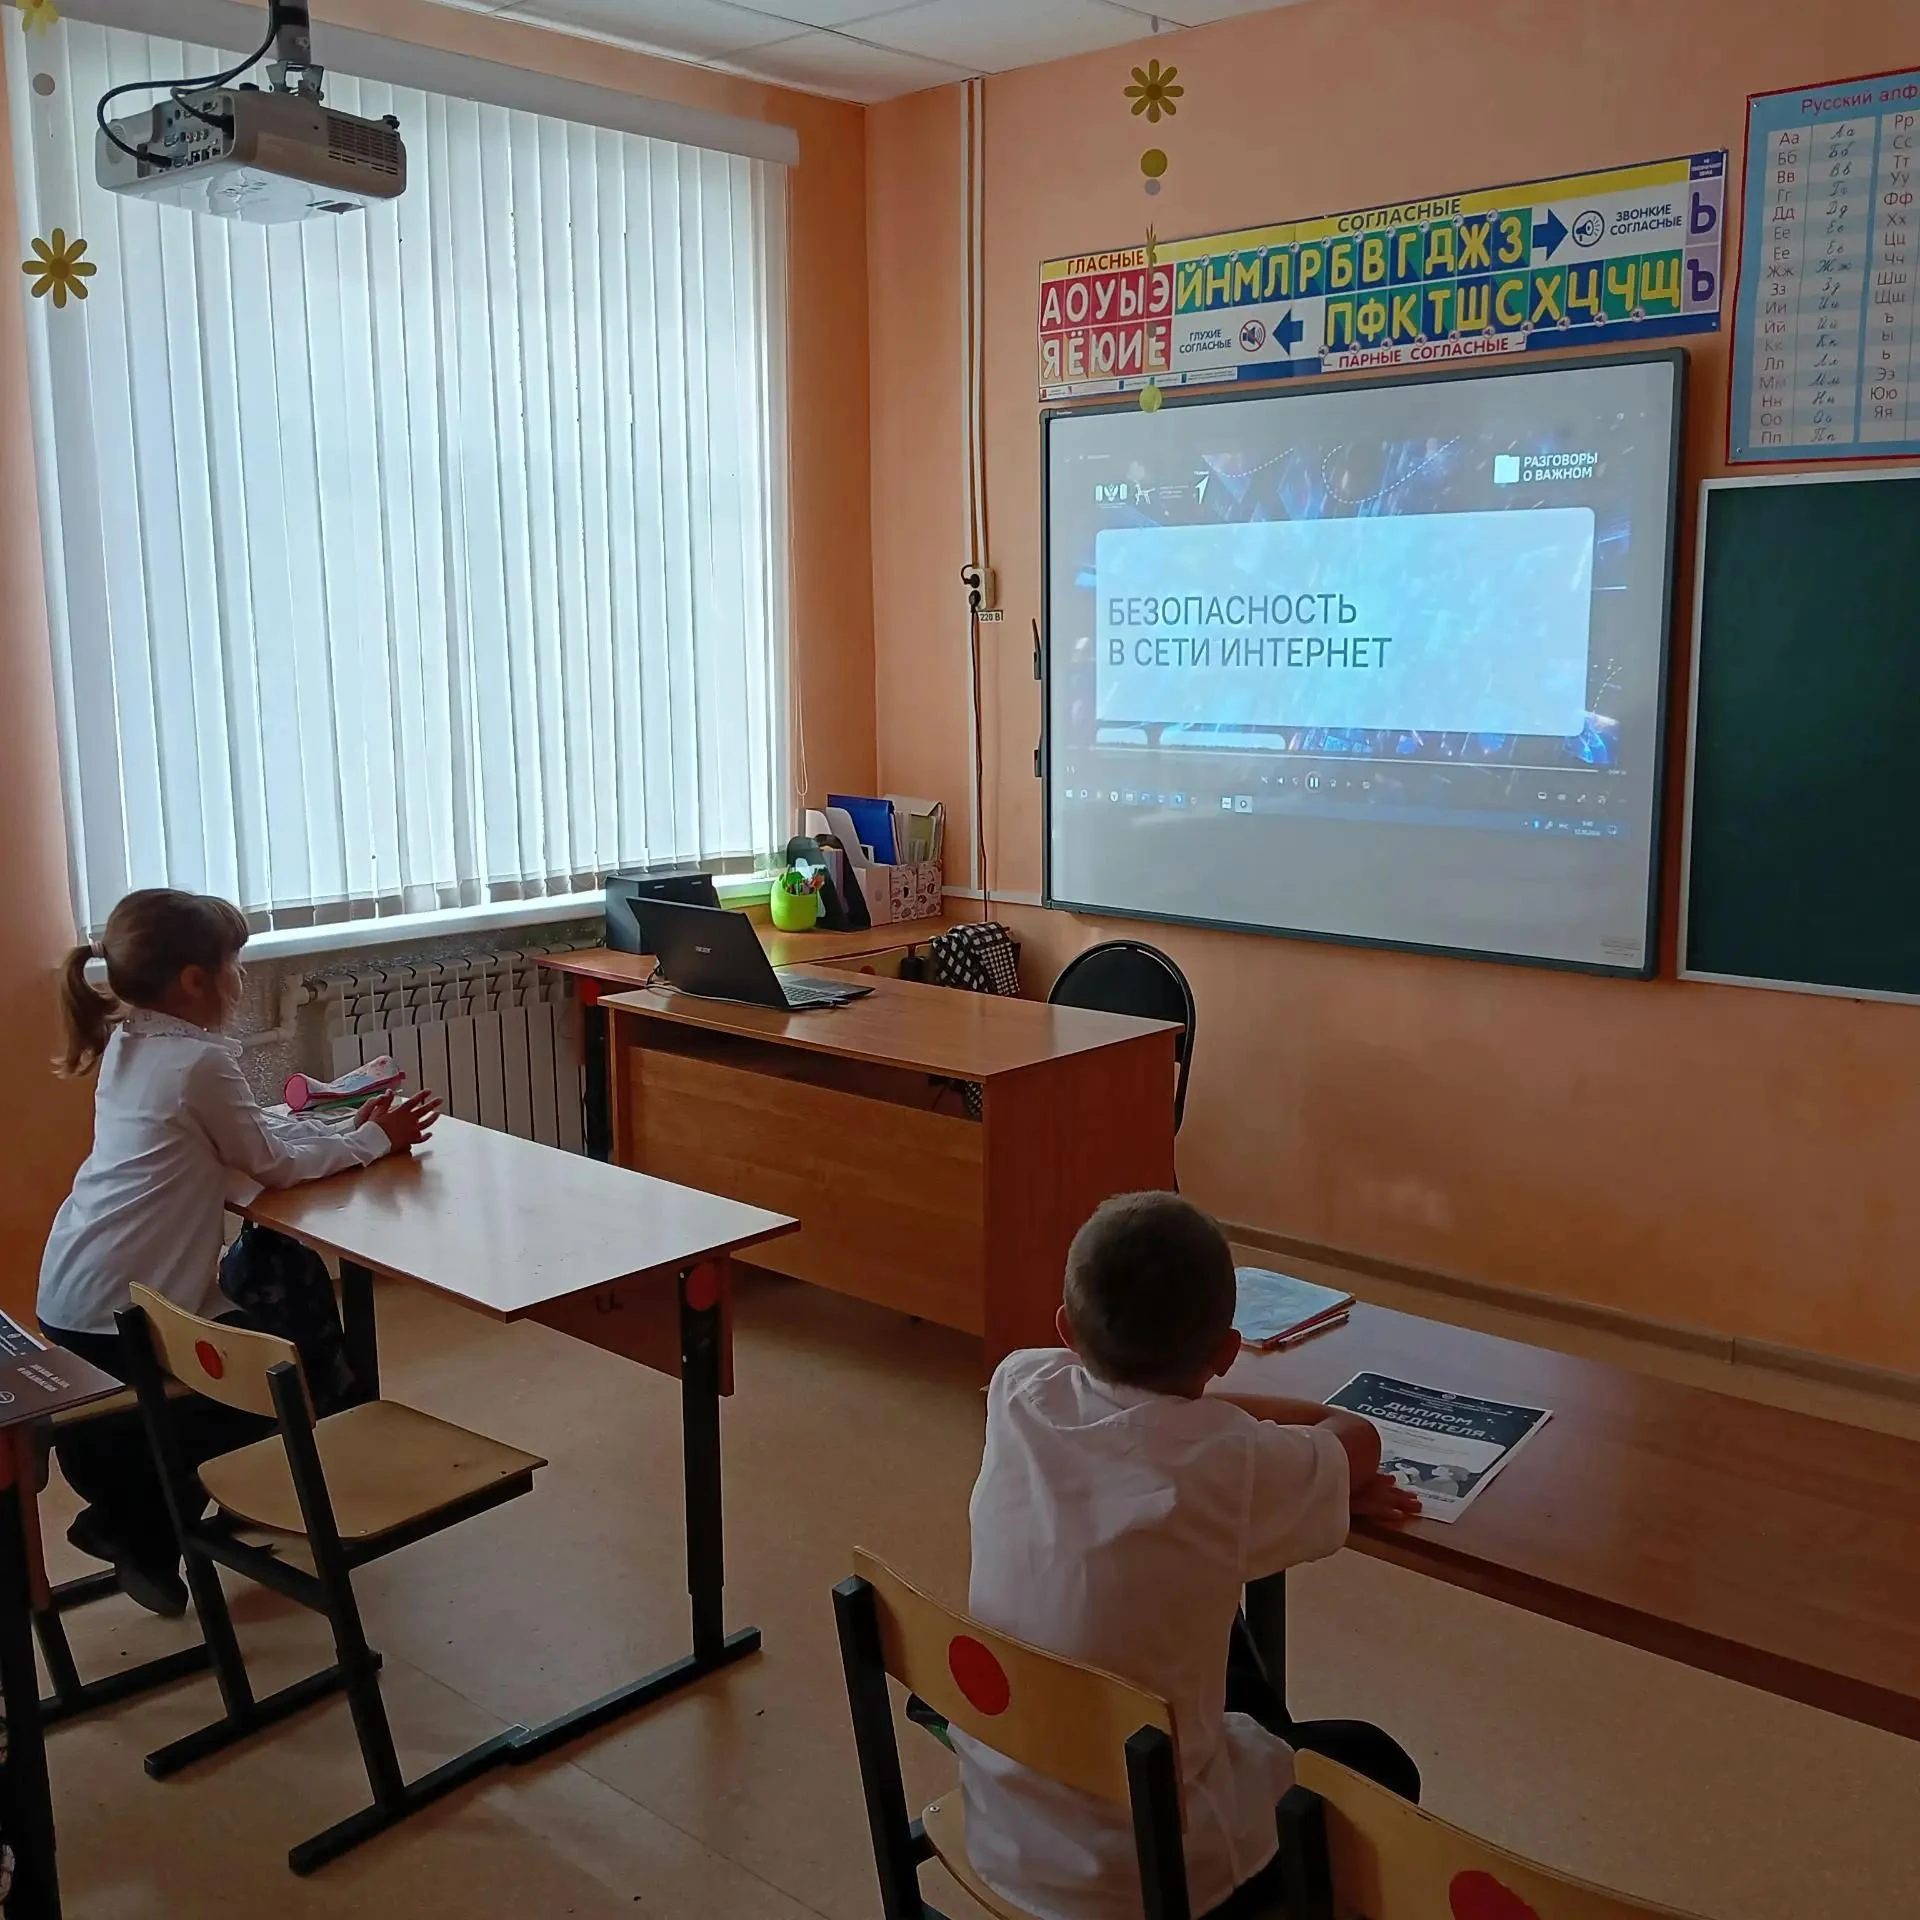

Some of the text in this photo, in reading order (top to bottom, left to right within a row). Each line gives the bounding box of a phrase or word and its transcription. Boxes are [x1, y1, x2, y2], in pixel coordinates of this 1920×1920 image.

[1801, 92, 1872, 116] Русский
[1894, 114, 1914, 130] Рр
[1779, 132, 1800, 146] Аа
[1893, 136, 1912, 150] Сс
[1777, 149, 1797, 166] Бб
[1893, 155, 1911, 169] Тт
[1777, 170, 1796, 184] Вв
[1890, 171, 1910, 187] Уу
[1883, 192, 1913, 208] Фф
[1337, 198, 1461, 234] СОГЛАСНЫЕ
[1615, 203, 1672, 223] ЗВОНКИЕ
[1772, 206, 1795, 222] Дд
[1887, 213, 1907, 227] Хх
[1609, 215, 1682, 236] СОГЛАСНЫЕ
[1066, 250, 1145, 276] ГЛАСНЫЕ
[1767, 264, 1795, 278] Жж
[1769, 282, 1786, 296] Зз
[1189, 328, 1222, 342] ГЛУХИЕ
[1179, 337, 1232, 354] СОГЛАСНЫЕ
[1338, 337, 1509, 369] ПАРНЫЕ СОГЛАСНЫЕ
[1870, 386, 1898, 401] Юю
[1760, 412, 1782, 426] Оо
[1874, 405, 1893, 419] Яя
[1761, 431, 1782, 444] Пп
[1524, 452, 1598, 468] РАЗГОВОРЫ
[1523, 466, 1593, 482] О ВАЖНОМ
[980, 613, 993, 622] 220
[1108, 593, 1358, 627] БЕЗОПАСНОСТЬ
[1108, 636, 1393, 669] В СЕТИ ИНТЕРНЕТ
[1356, 1403, 1487, 1438] ПОБЕДИТЕЛЯ
[1384, 1401, 1473, 1426] ДИПЛОМ
